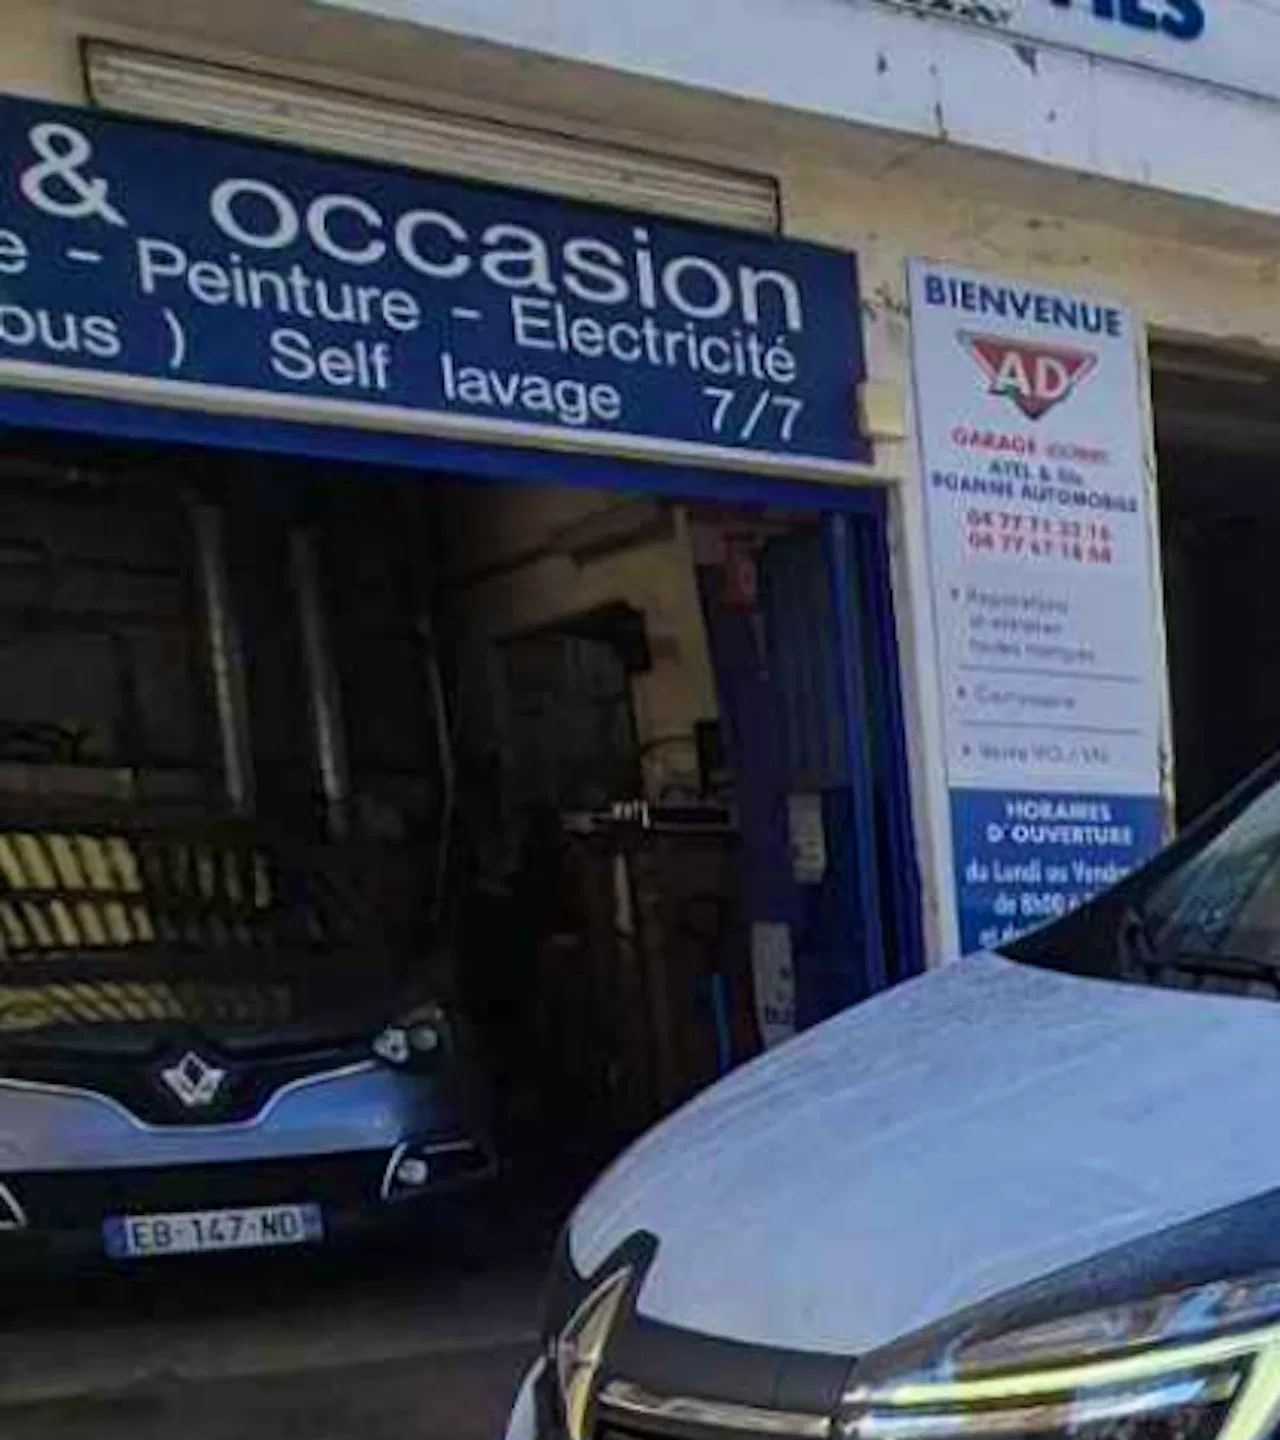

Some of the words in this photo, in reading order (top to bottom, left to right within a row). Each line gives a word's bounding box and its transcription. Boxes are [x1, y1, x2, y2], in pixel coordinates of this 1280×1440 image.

[20, 122, 128, 227] &
[209, 178, 803, 332] occasion
[137, 236, 421, 331] Peinture
[511, 296, 797, 383] Electricité
[924, 275, 1123, 337] BIENVENUE
[270, 328, 390, 389] Self
[440, 353, 621, 425] lavage
[704, 387, 803, 442] 7/7
[995, 350, 1068, 400] AD
[952, 425, 1036, 455] GARAGE
[1005, 799, 1112, 822] HORAIRES
